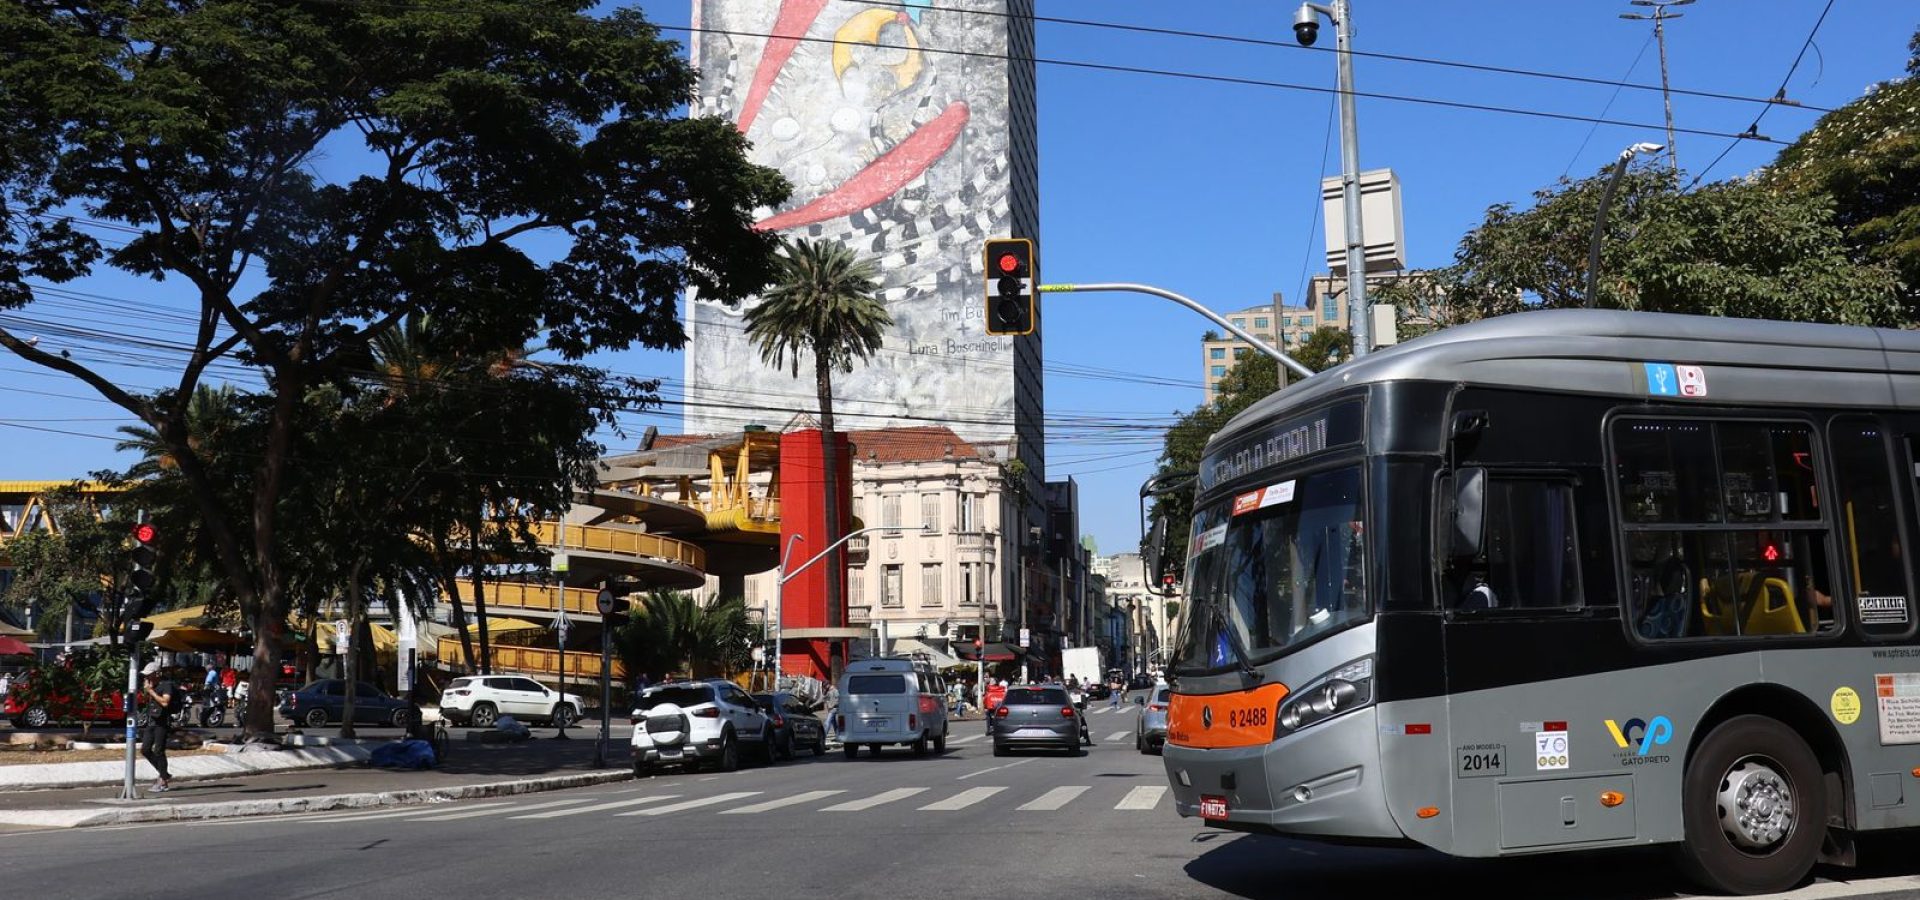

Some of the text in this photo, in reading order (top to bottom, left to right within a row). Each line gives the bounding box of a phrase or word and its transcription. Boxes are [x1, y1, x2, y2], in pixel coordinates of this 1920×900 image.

[940, 307, 960, 321] Tim
[1229, 707, 1267, 728] 8 2488
[1463, 753, 1501, 771] 2014
[1622, 755, 1670, 766] GATO PRETO
